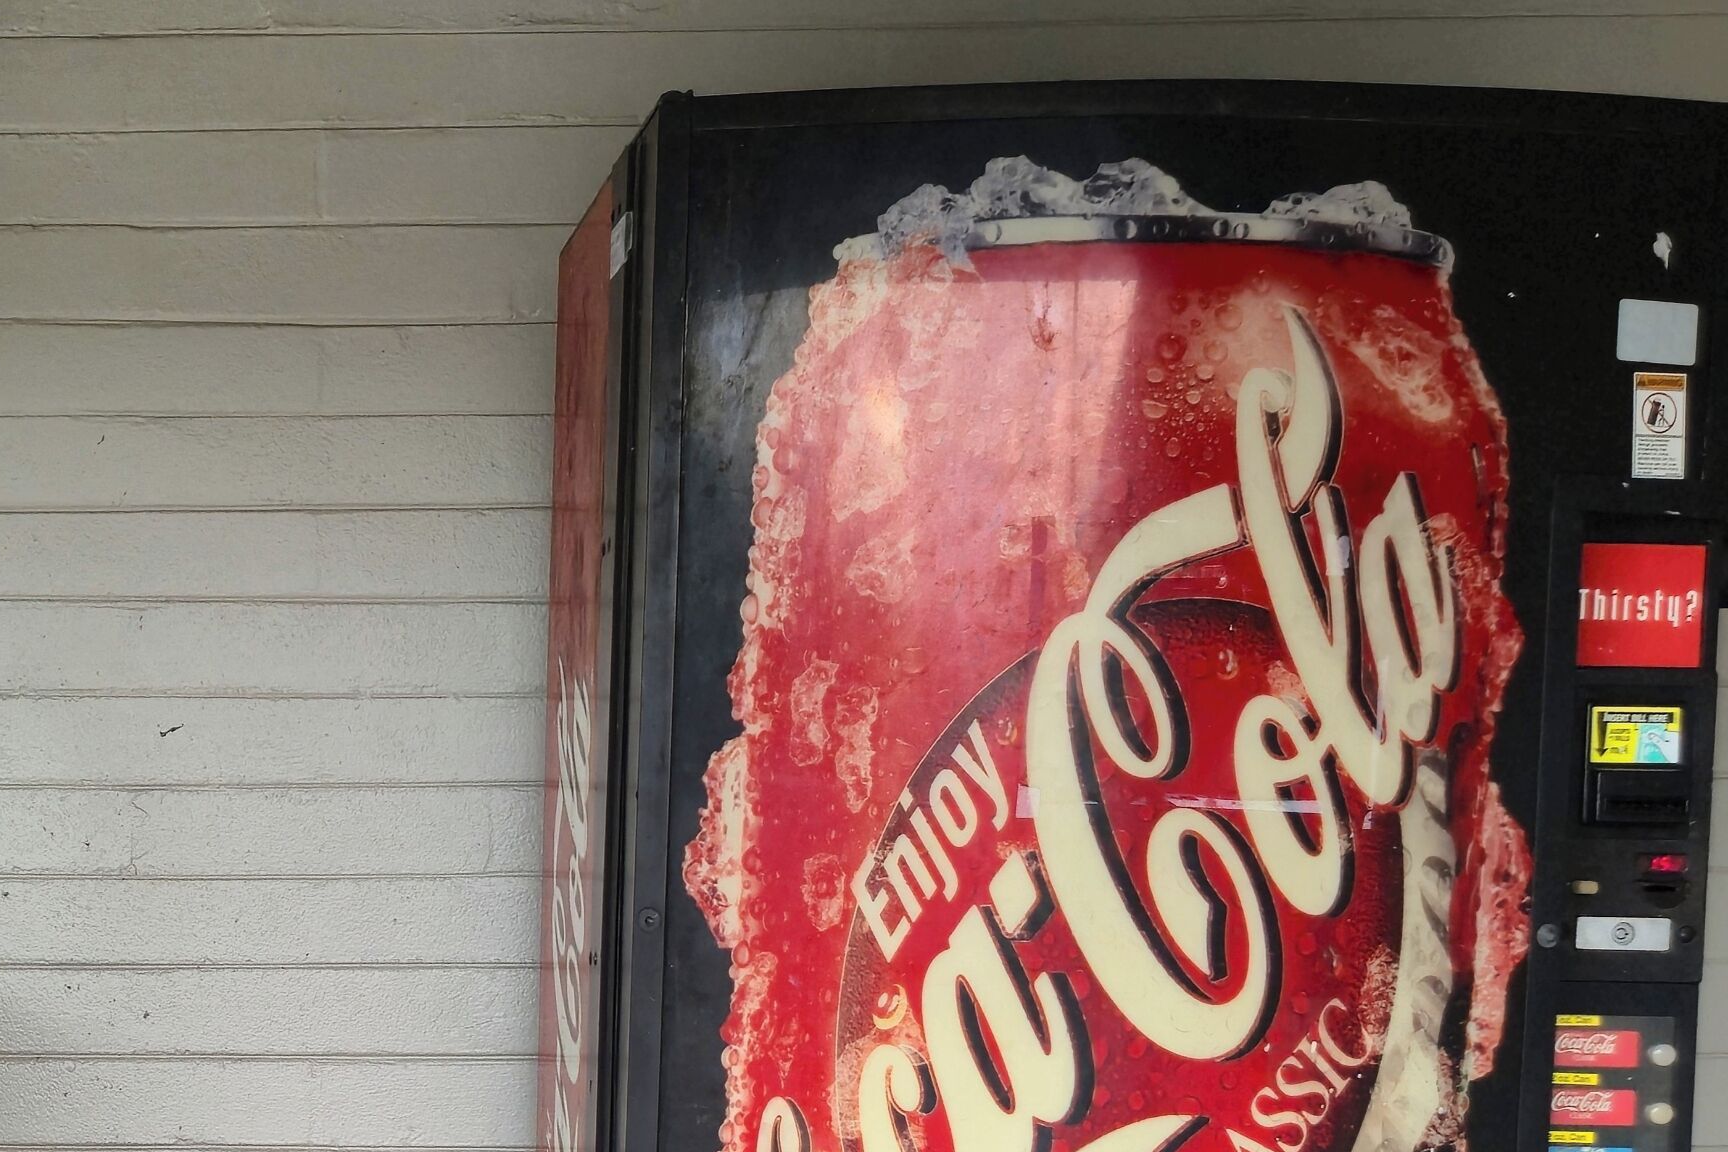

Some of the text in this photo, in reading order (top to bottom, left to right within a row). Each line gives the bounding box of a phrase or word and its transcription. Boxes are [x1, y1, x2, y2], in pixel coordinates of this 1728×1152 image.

[1578, 588, 1699, 628] Thirsty?
[851, 718, 1011, 963] Enjoy
[1554, 1033, 1618, 1054] Coca-Cola
[1551, 1091, 1615, 1112] Coca-Cola
